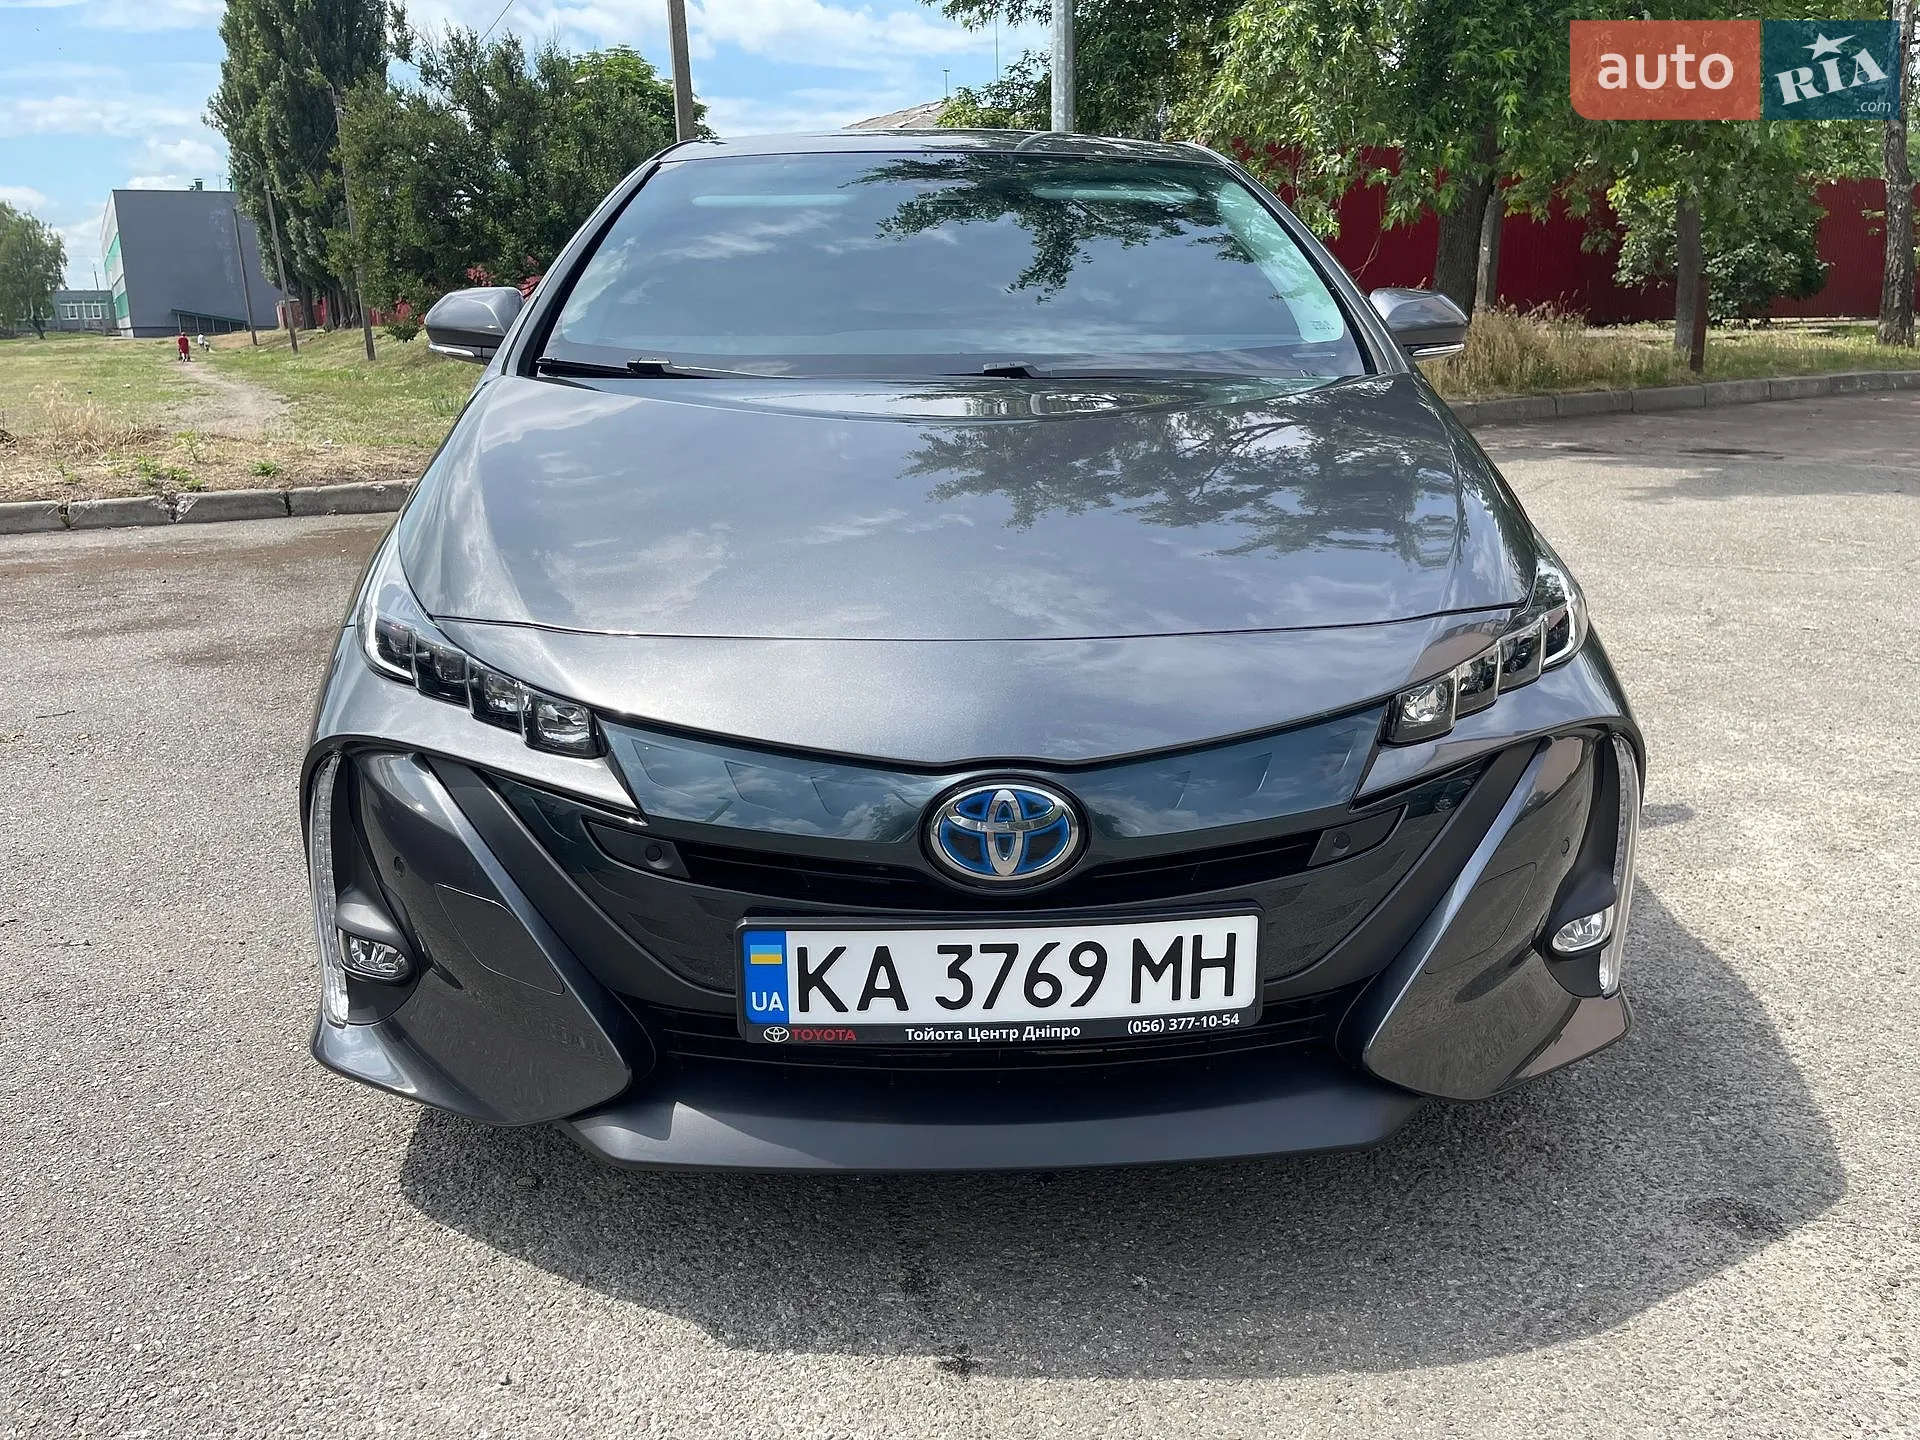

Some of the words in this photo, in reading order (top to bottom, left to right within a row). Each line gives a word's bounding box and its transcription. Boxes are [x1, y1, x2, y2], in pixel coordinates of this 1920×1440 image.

[796, 944, 910, 1013] KA
[934, 940, 1108, 1011] 3769
[1130, 931, 1237, 1005] MH
[751, 991, 785, 1012] UA
[905, 1027, 963, 1042] Тойота
[968, 1027, 1019, 1043] Центр
[1022, 1025, 1081, 1042] Дніпро
[1127, 1018, 1165, 1035] (056)
[1169, 1013, 1240, 1032] 377-10-54
[791, 1028, 857, 1042] TOYOTA
